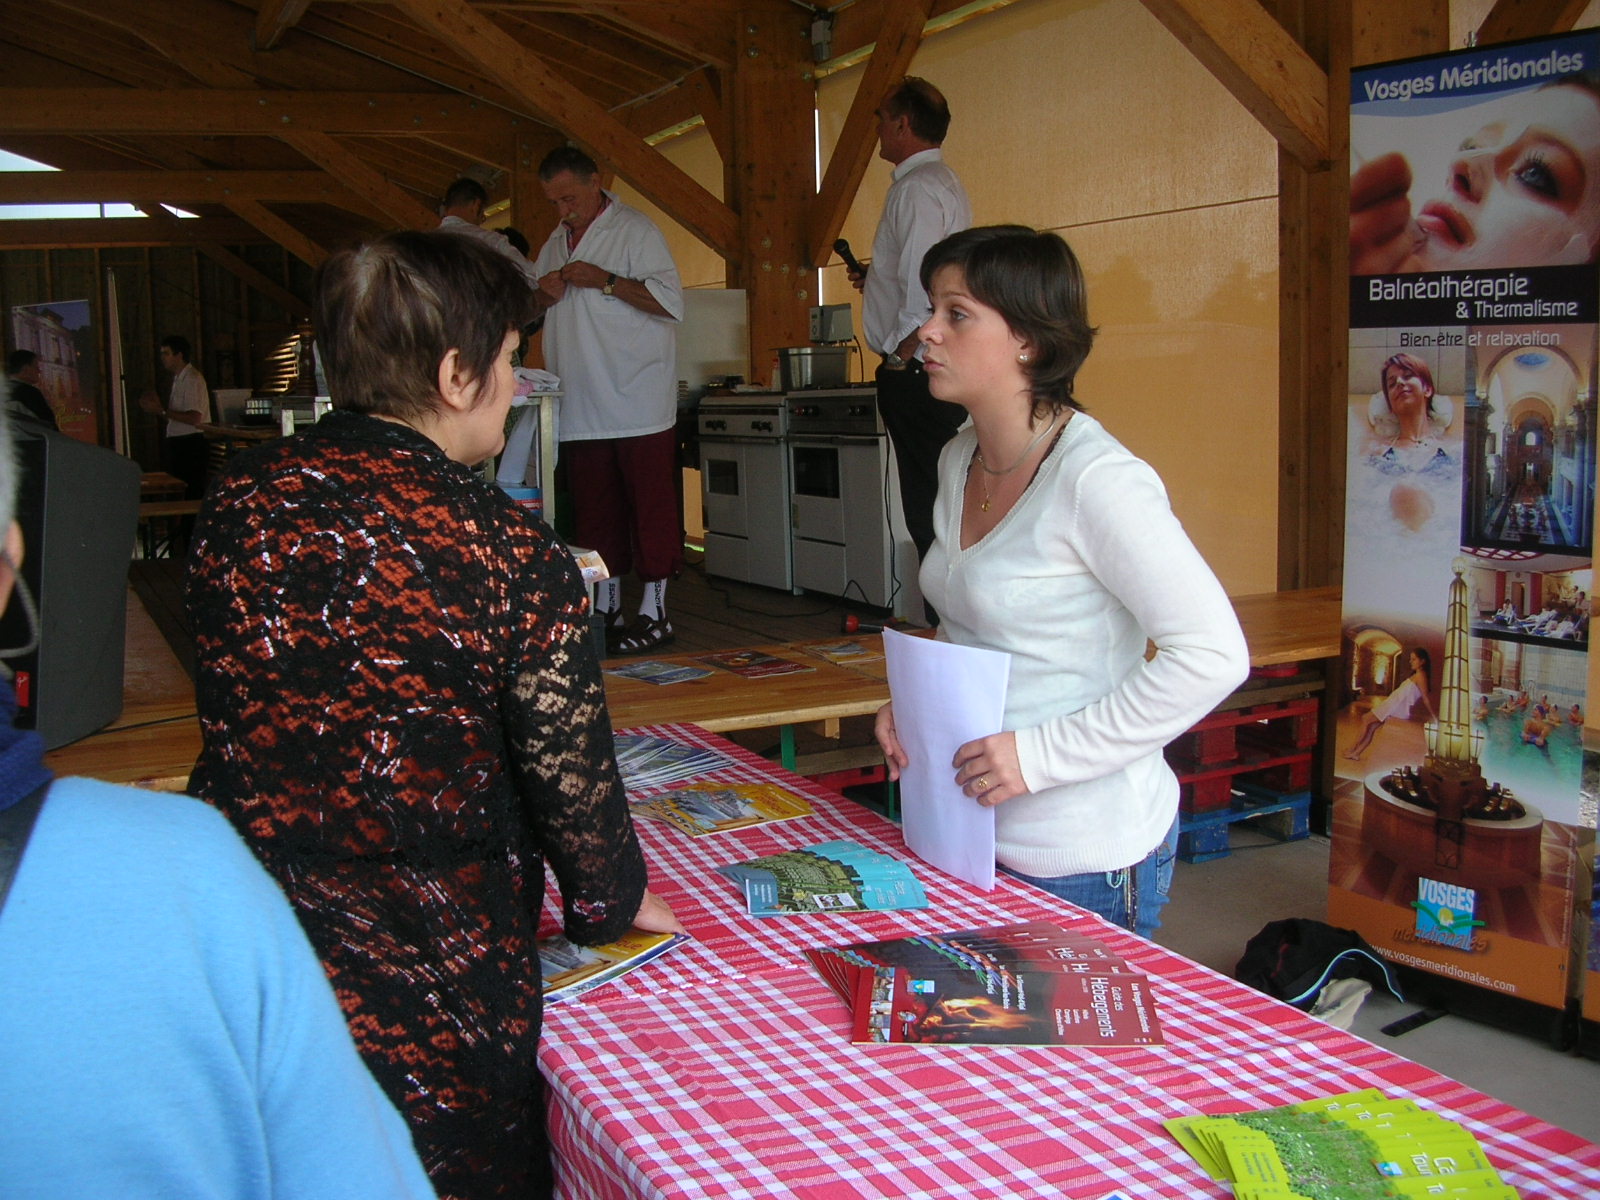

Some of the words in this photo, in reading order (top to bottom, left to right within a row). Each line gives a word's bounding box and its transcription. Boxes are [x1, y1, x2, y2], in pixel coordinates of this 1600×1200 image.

[1364, 75, 1435, 101] Vosges
[1439, 50, 1584, 91] Méridionales
[1369, 272, 1528, 301] Balnéothérapie
[1455, 301, 1469, 319] &
[1474, 298, 1578, 318] Thermalisme
[1400, 331, 1463, 347] Bien-être
[1468, 332, 1481, 346] et
[1486, 329, 1560, 346] relaxation
[1418, 876, 1475, 913] VOSGES
[1369, 943, 1516, 993] ww.vosgesmeridionales.com
[1090, 977, 1117, 1037] Hébergements
